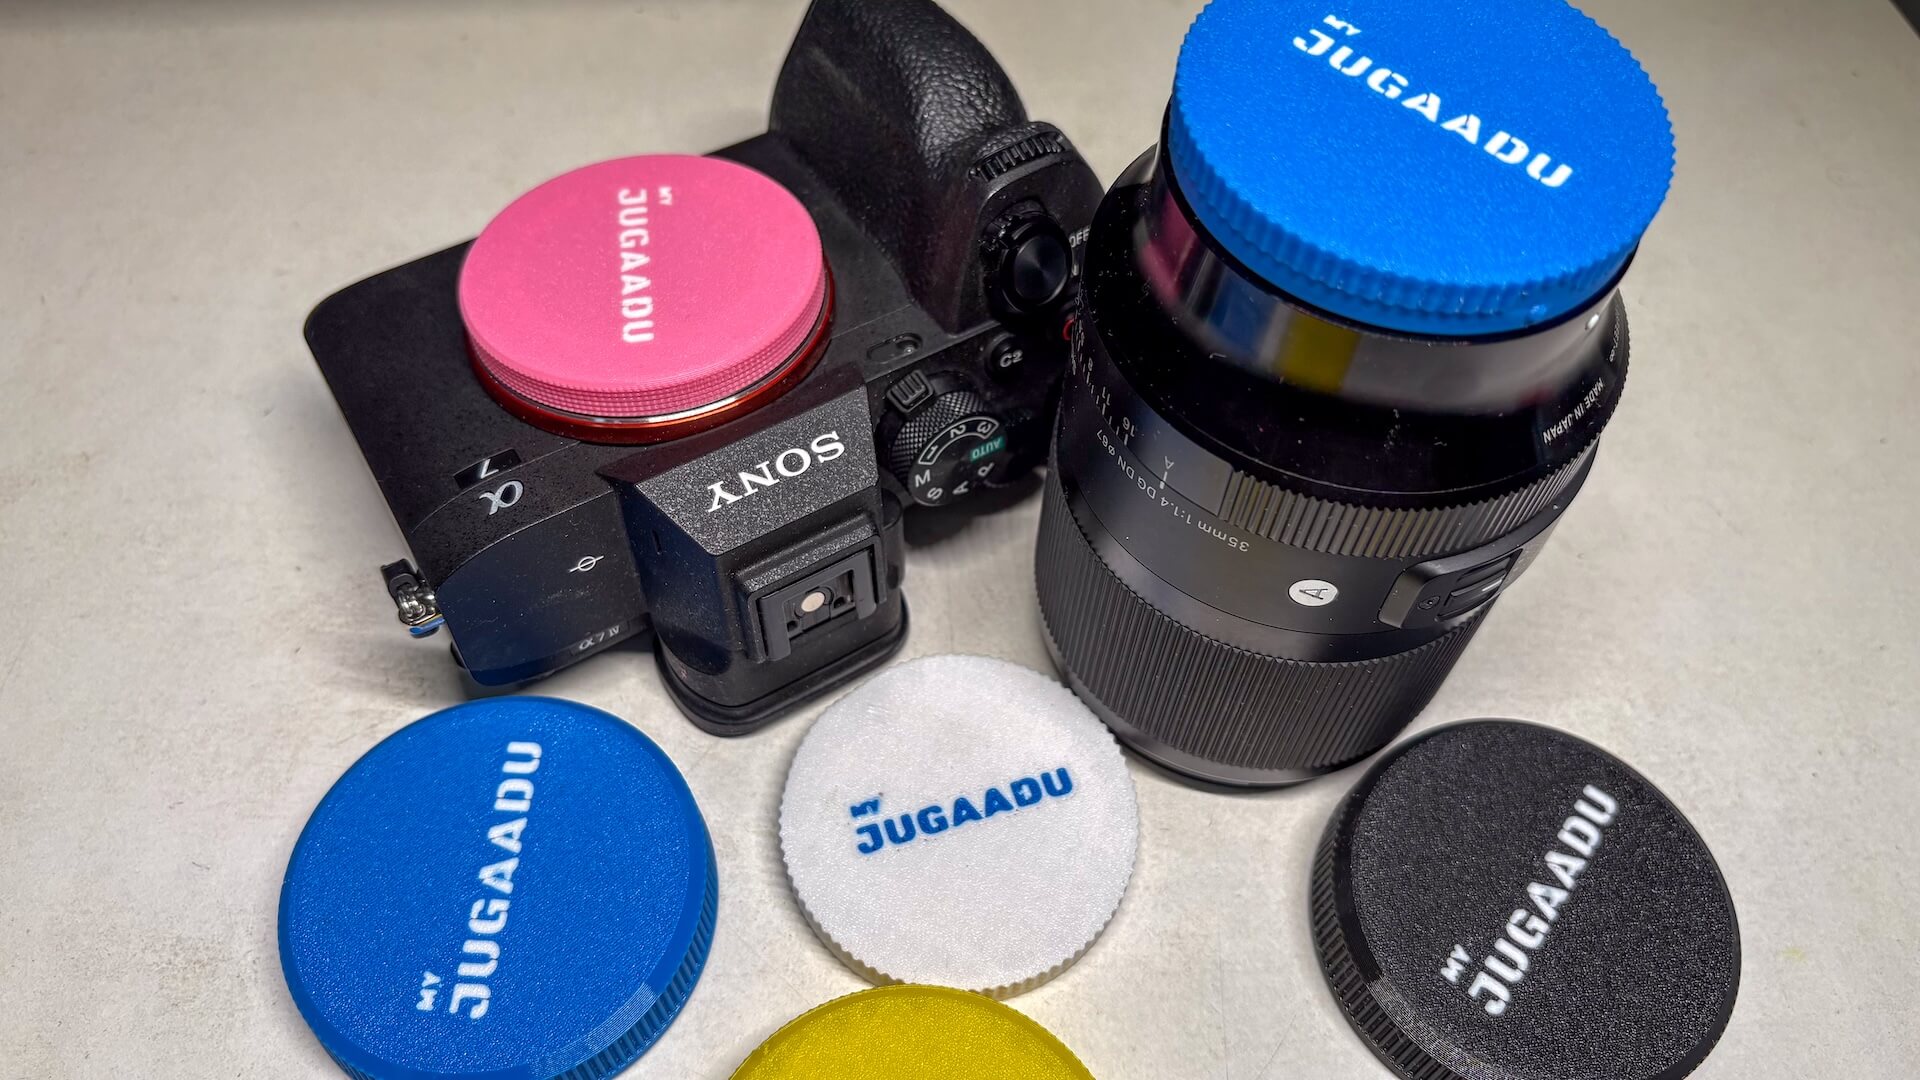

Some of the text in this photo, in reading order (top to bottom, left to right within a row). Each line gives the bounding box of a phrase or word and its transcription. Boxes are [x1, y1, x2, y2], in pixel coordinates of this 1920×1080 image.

[1292, 29, 1573, 188] JUGAADU
[658, 186, 672, 206] MY
[1069, 228, 1090, 248] OFF
[618, 188, 655, 343] JUGAADU
[1000, 349, 1023, 367] C2
[1102, 386, 1111, 405] 11
[1543, 377, 1604, 445] MADE IN JAPAN
[950, 424, 967, 438] 2
[977, 421, 992, 434] 3
[1122, 416, 1135, 437] 16
[926, 445, 939, 460] 1
[971, 437, 1003, 459] AUTO
[707, 431, 845, 513] SONY
[978, 462, 994, 477] P
[1117, 455, 1135, 480] DN
[1165, 456, 1175, 470] A
[915, 469, 931, 488] M
[952, 480, 969, 495] A
[1137, 477, 1157, 499] DG
[927, 487, 943, 500] S
[1160, 496, 1192, 525] 1:1.4
[1198, 520, 1250, 552] 35mm
[856, 767, 1073, 855] JUGAADU
[449, 741, 543, 1020] JUGAADU
[1468, 784, 1618, 1016] JUGAADU
[1440, 943, 1471, 983] MY
[416, 971, 441, 1011] MY
